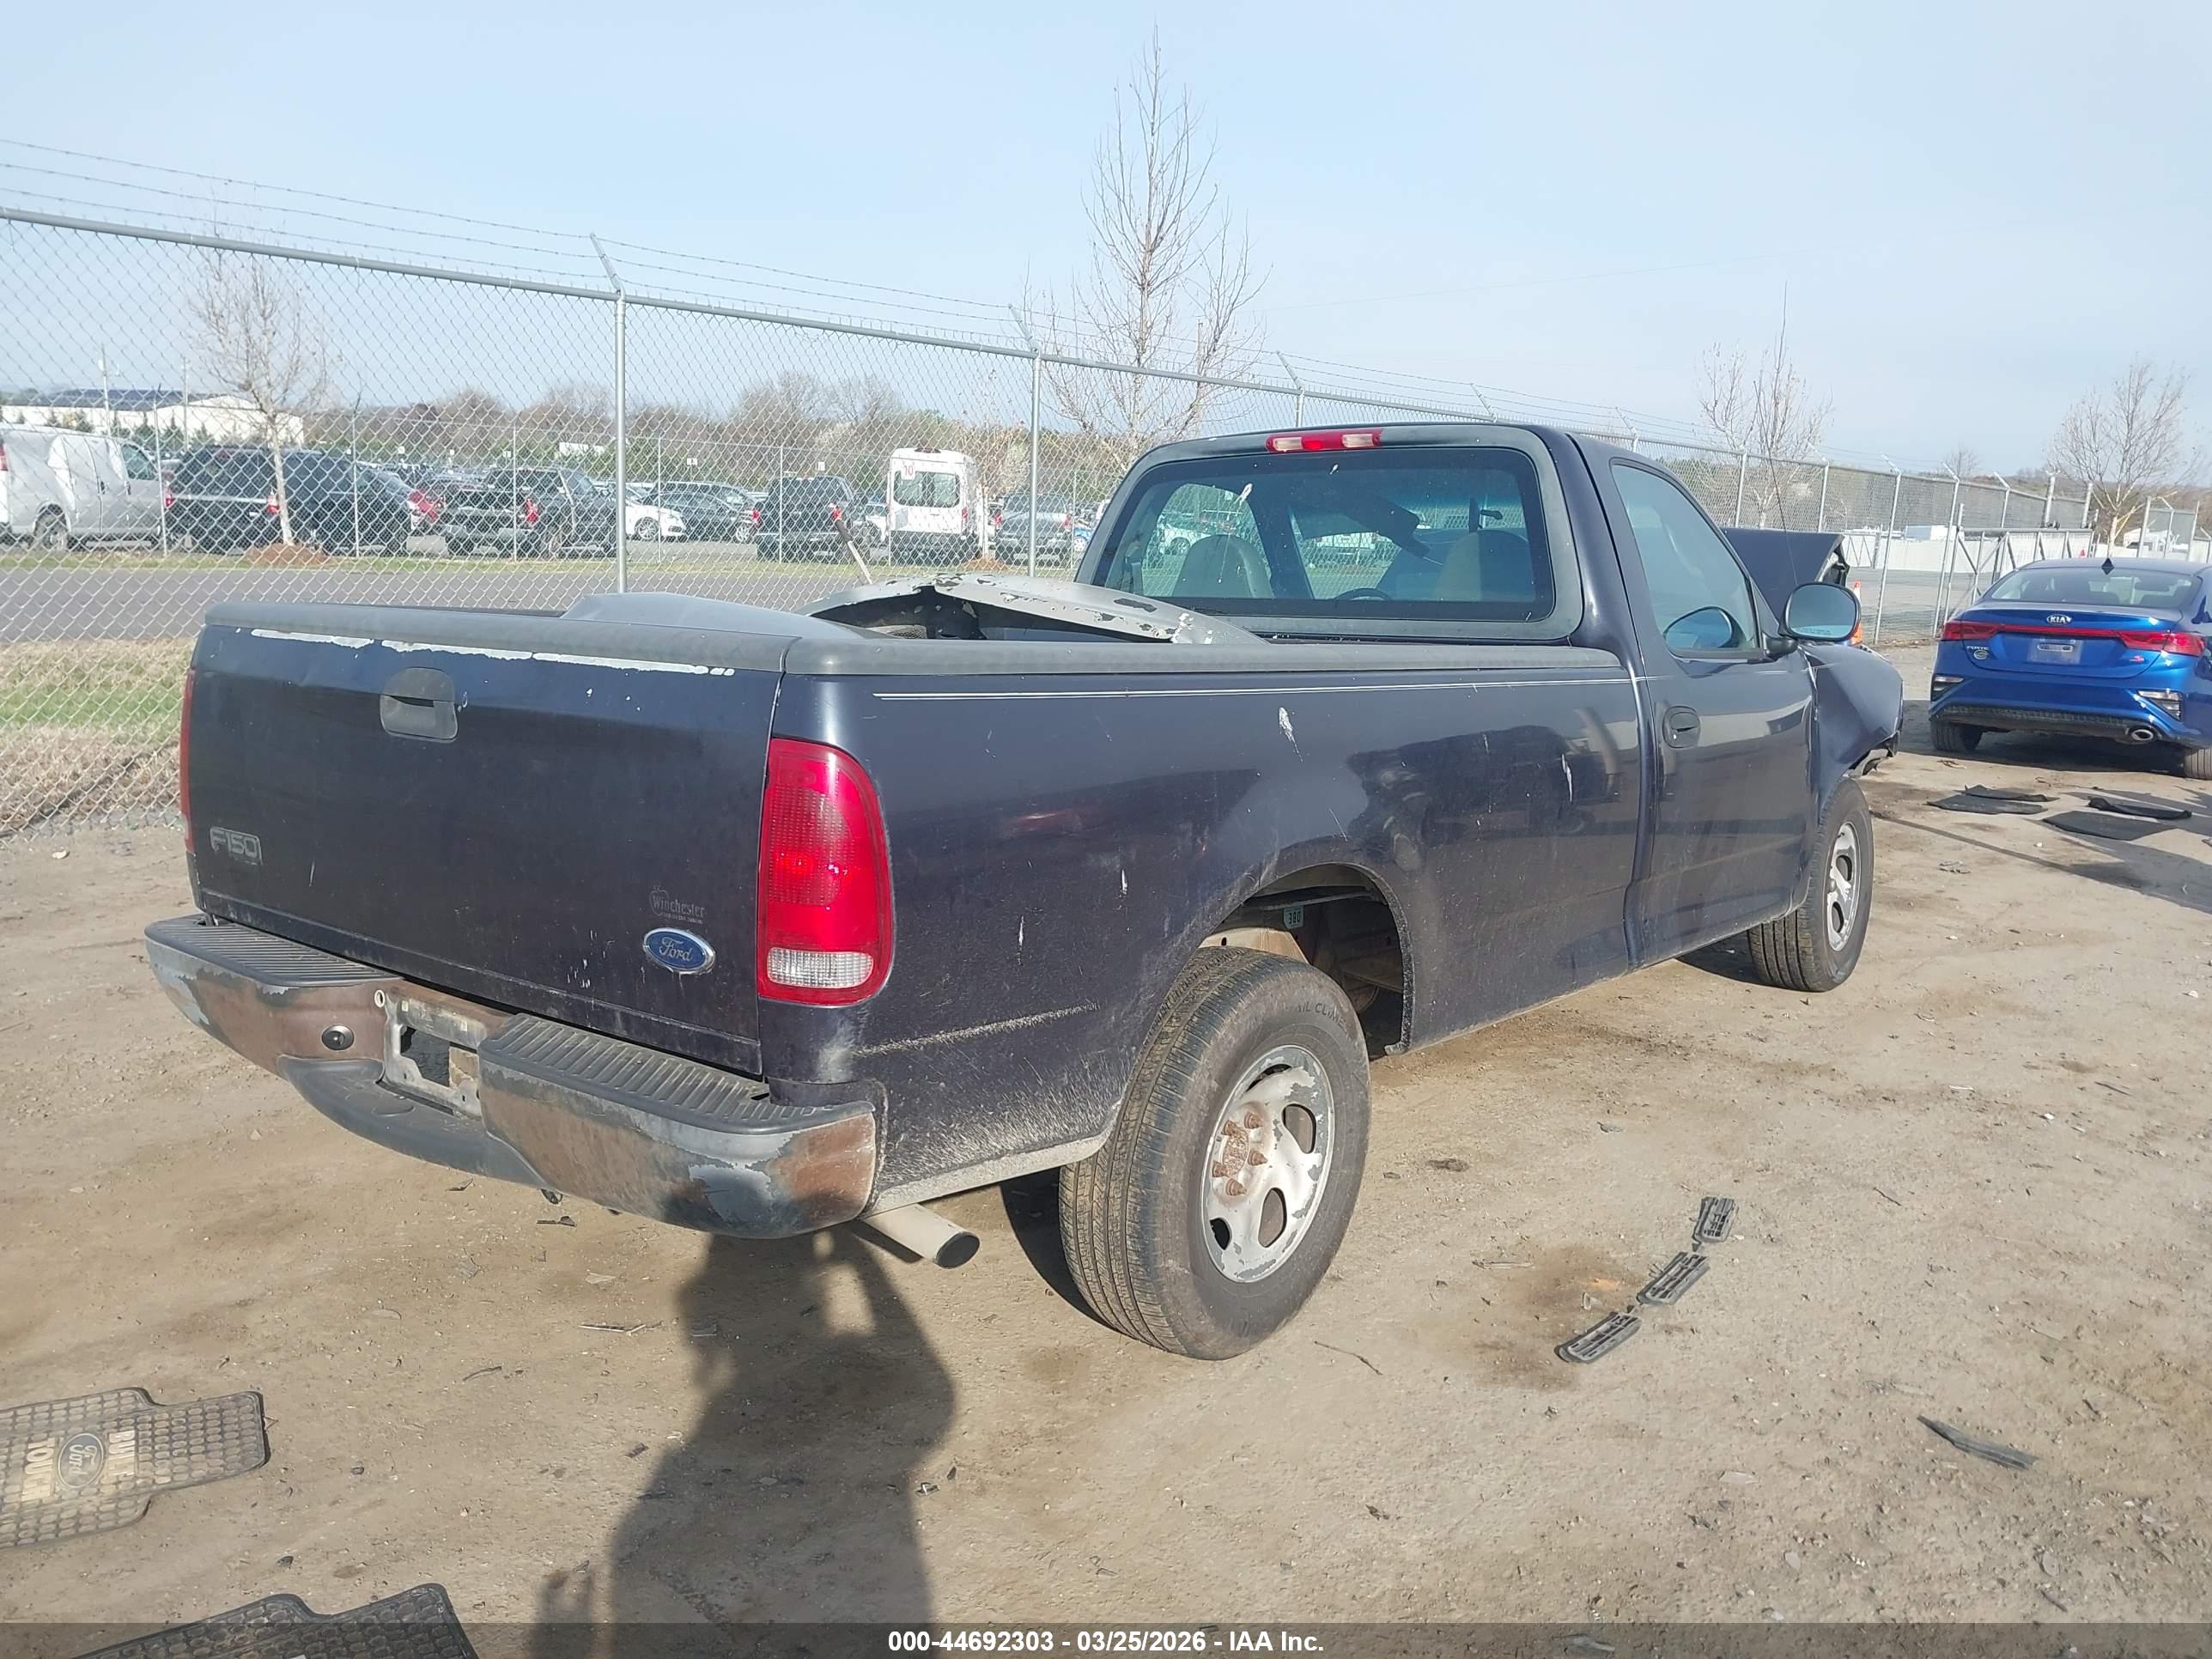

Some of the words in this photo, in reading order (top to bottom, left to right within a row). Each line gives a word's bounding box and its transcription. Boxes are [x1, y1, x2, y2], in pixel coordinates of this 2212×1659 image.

[2050, 616, 2067, 625] KIA
[652, 894, 705, 918] Winchester
[659, 936, 694, 962] Ford
[69, 1443, 98, 1476] Ford
